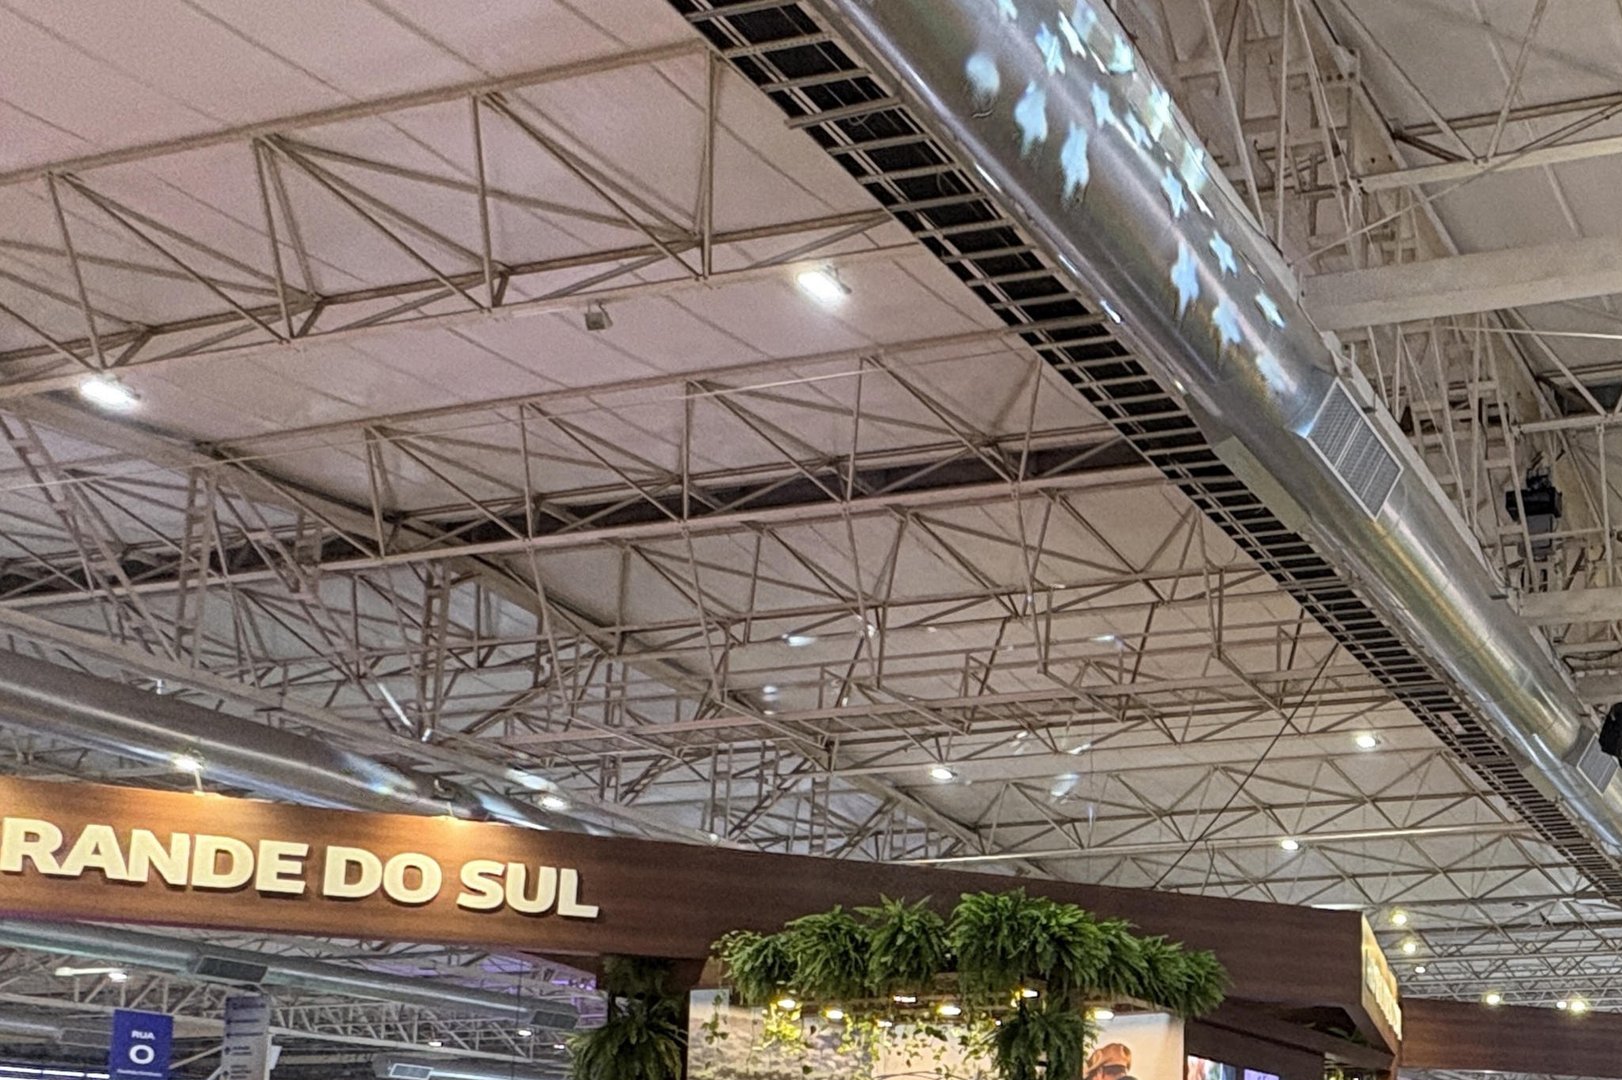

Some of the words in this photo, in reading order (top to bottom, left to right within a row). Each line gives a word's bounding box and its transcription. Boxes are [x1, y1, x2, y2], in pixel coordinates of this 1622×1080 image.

[0, 817, 309, 896] RANDE
[323, 845, 443, 904] DO
[456, 859, 600, 918] SUL
[131, 1030, 155, 1040] RUA
[128, 1044, 155, 1064] O
